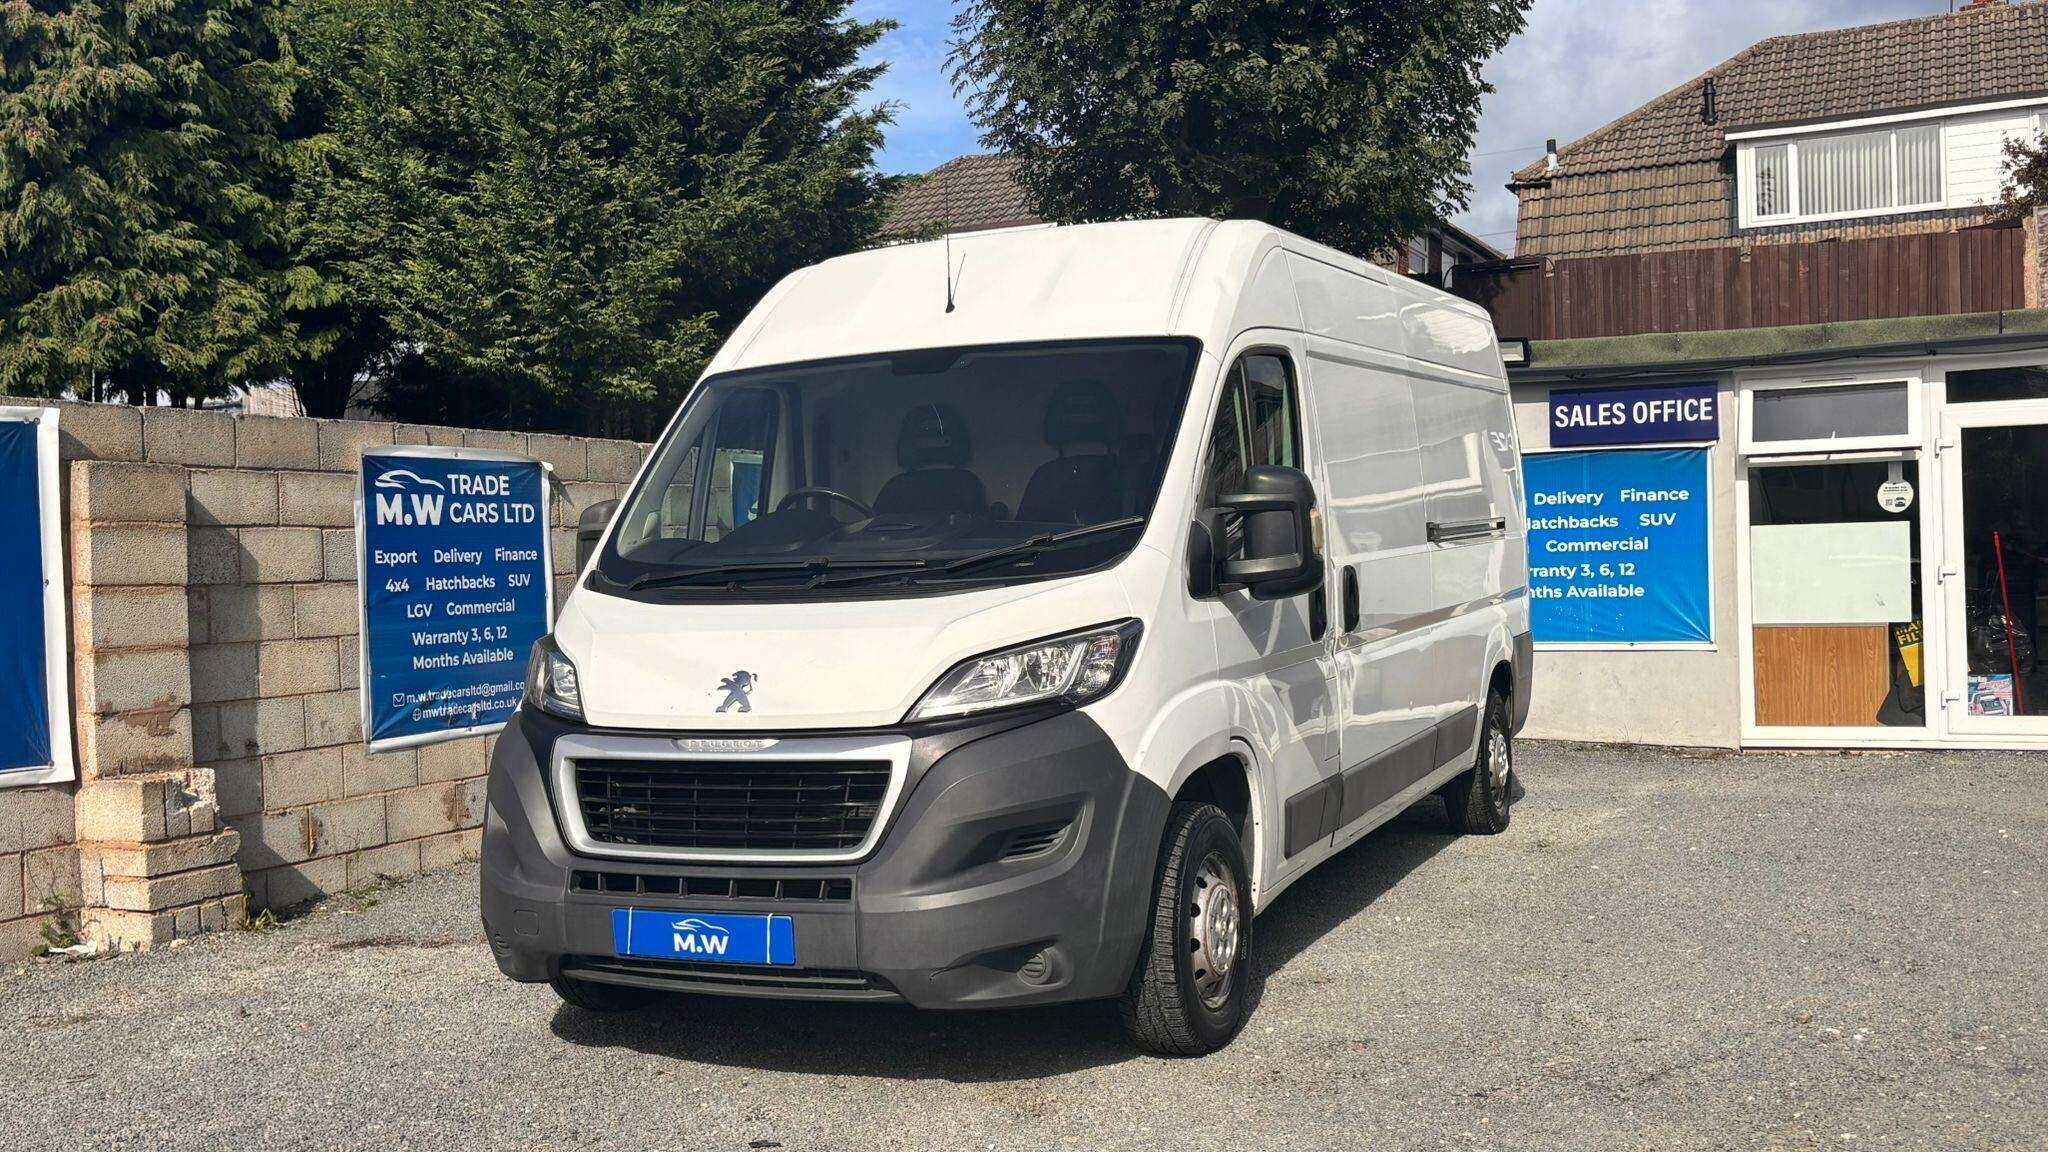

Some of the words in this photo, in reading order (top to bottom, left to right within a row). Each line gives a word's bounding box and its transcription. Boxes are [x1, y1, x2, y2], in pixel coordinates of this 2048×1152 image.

[1554, 402, 1626, 428] SALES
[1632, 397, 1713, 424] OFFICE
[447, 474, 510, 496] TRADE
[1534, 491, 1604, 507] Delivery
[1620, 488, 1690, 502] Finance
[375, 493, 444, 526] M.W
[450, 503, 498, 523] CARS
[503, 503, 535, 523] LTD
[1639, 512, 1677, 527] SUV
[1545, 537, 1649, 553] Commercial
[375, 549, 418, 567] Export
[434, 549, 482, 565] Delivery
[495, 547, 538, 561] Finance
[1580, 563, 1595, 578] 3,
[1599, 563, 1615, 578] 6,
[1619, 563, 1635, 576] 12
[386, 578, 410, 592] 4x4
[426, 575, 496, 591] Hatchbacks
[508, 574, 531, 587] SUV
[1567, 583, 1645, 598] Available
[407, 603, 433, 618] LGV
[446, 599, 516, 616] Commercial
[412, 629, 469, 647] Warranty
[471, 628, 482, 643] 3,
[483, 628, 494, 641] 6,
[496, 626, 508, 640] 12
[413, 654, 460, 670] Months
[462, 648, 514, 666] Available
[406, 681, 525, 704] m.w.tradecarsltd@gmail.co
[673, 933, 729, 954] M.W
